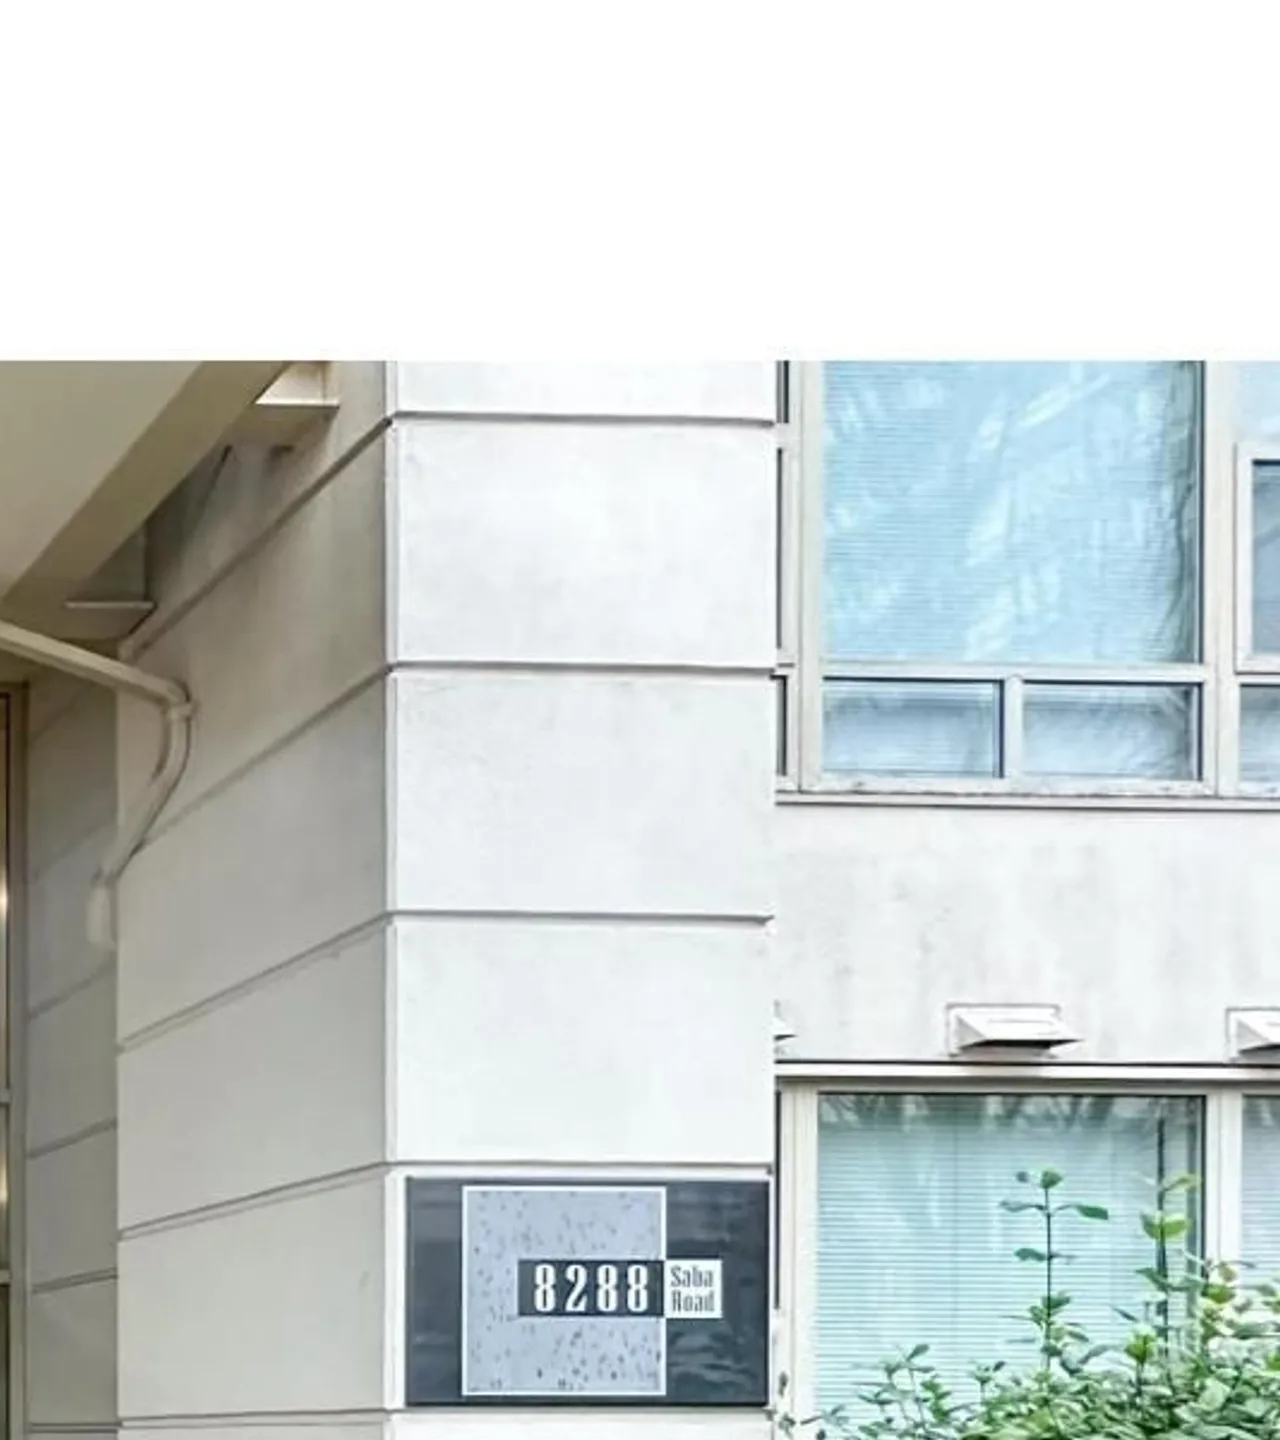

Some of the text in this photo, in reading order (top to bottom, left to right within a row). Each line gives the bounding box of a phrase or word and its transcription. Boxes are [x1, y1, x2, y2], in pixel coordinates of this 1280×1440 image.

[534, 1263, 650, 1313] 8288
[669, 1264, 715, 1288] Saba
[671, 1289, 716, 1313] Road
